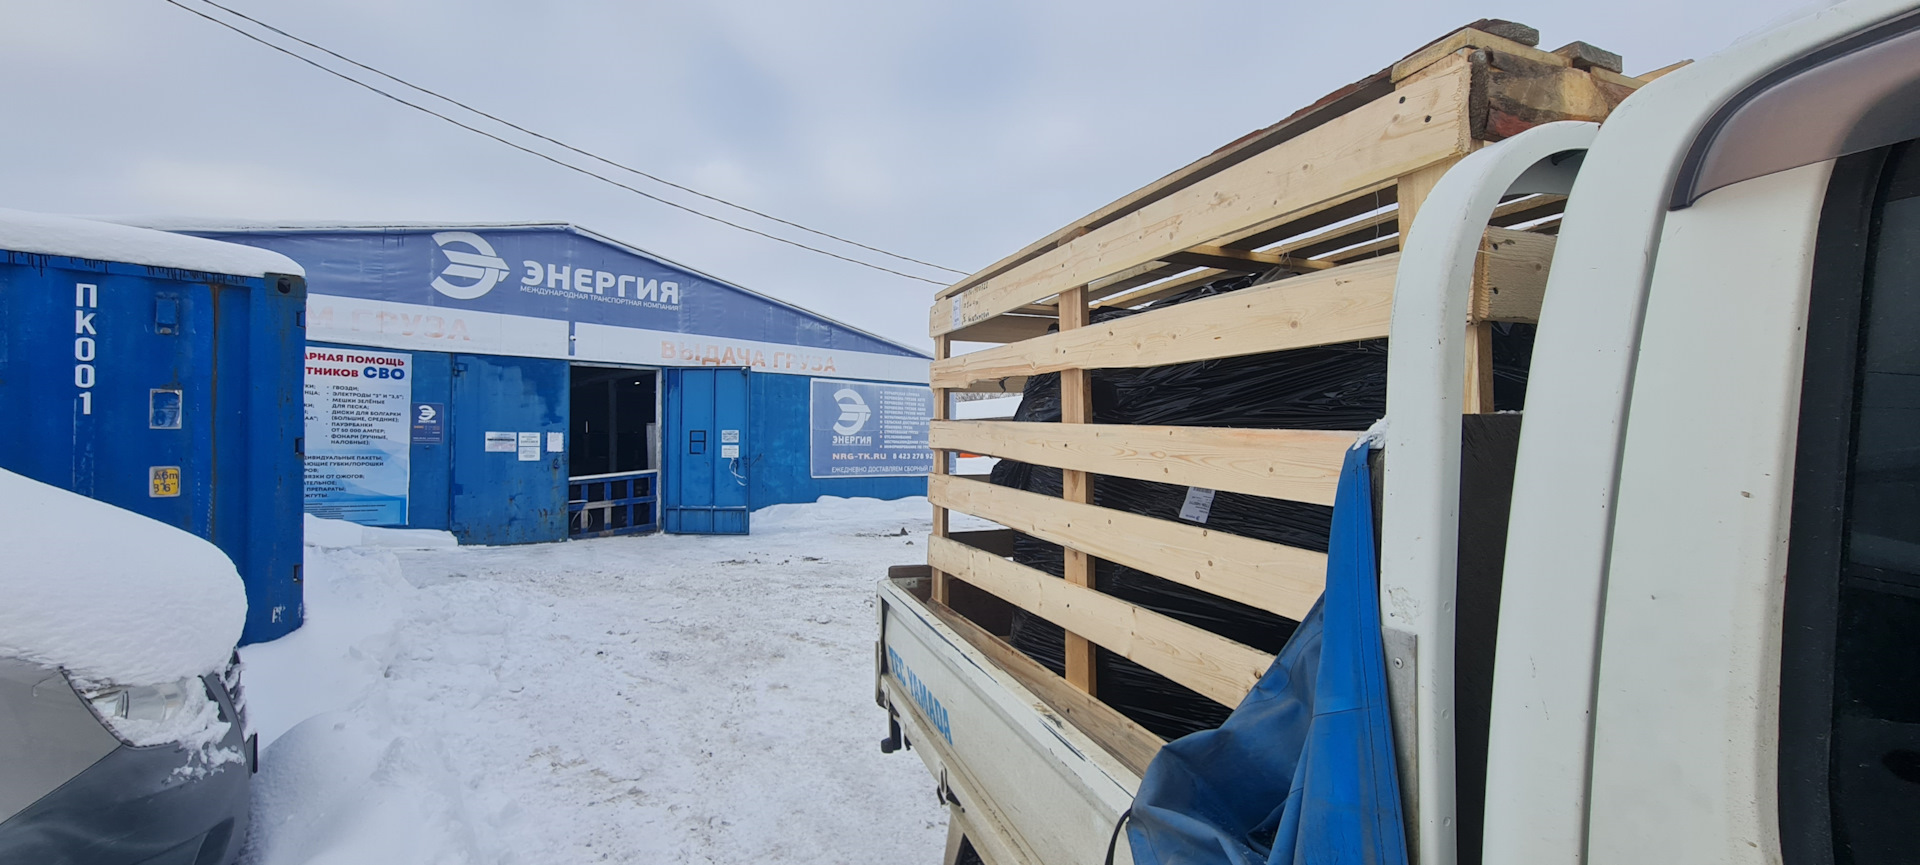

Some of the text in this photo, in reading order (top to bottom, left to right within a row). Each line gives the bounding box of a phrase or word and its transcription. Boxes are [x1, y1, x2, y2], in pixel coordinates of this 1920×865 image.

[520, 260, 680, 305] ЭНЕРГИЯ
[520, 285, 680, 311] МЕЖДУНАРОДНАЯ ТРАНСПОРТНАЯ КОМПАНИЯ
[346, 355, 405, 367] ПОМОЩЬ
[661, 341, 836, 372] ВЫДАЧА ГРУЗА
[306, 366, 405, 380] ТНИКОВ СВО
[832, 435, 872, 444] ЭНЕРГИЯ
[893, 452, 898, 460] 8
[898, 452, 911, 460] 423
[868, 465, 903, 473] ДОСТАВЛЯЕМ
[904, 464, 928, 472] СБОРНЫЙ
[906, 665, 954, 746] YAMADA
